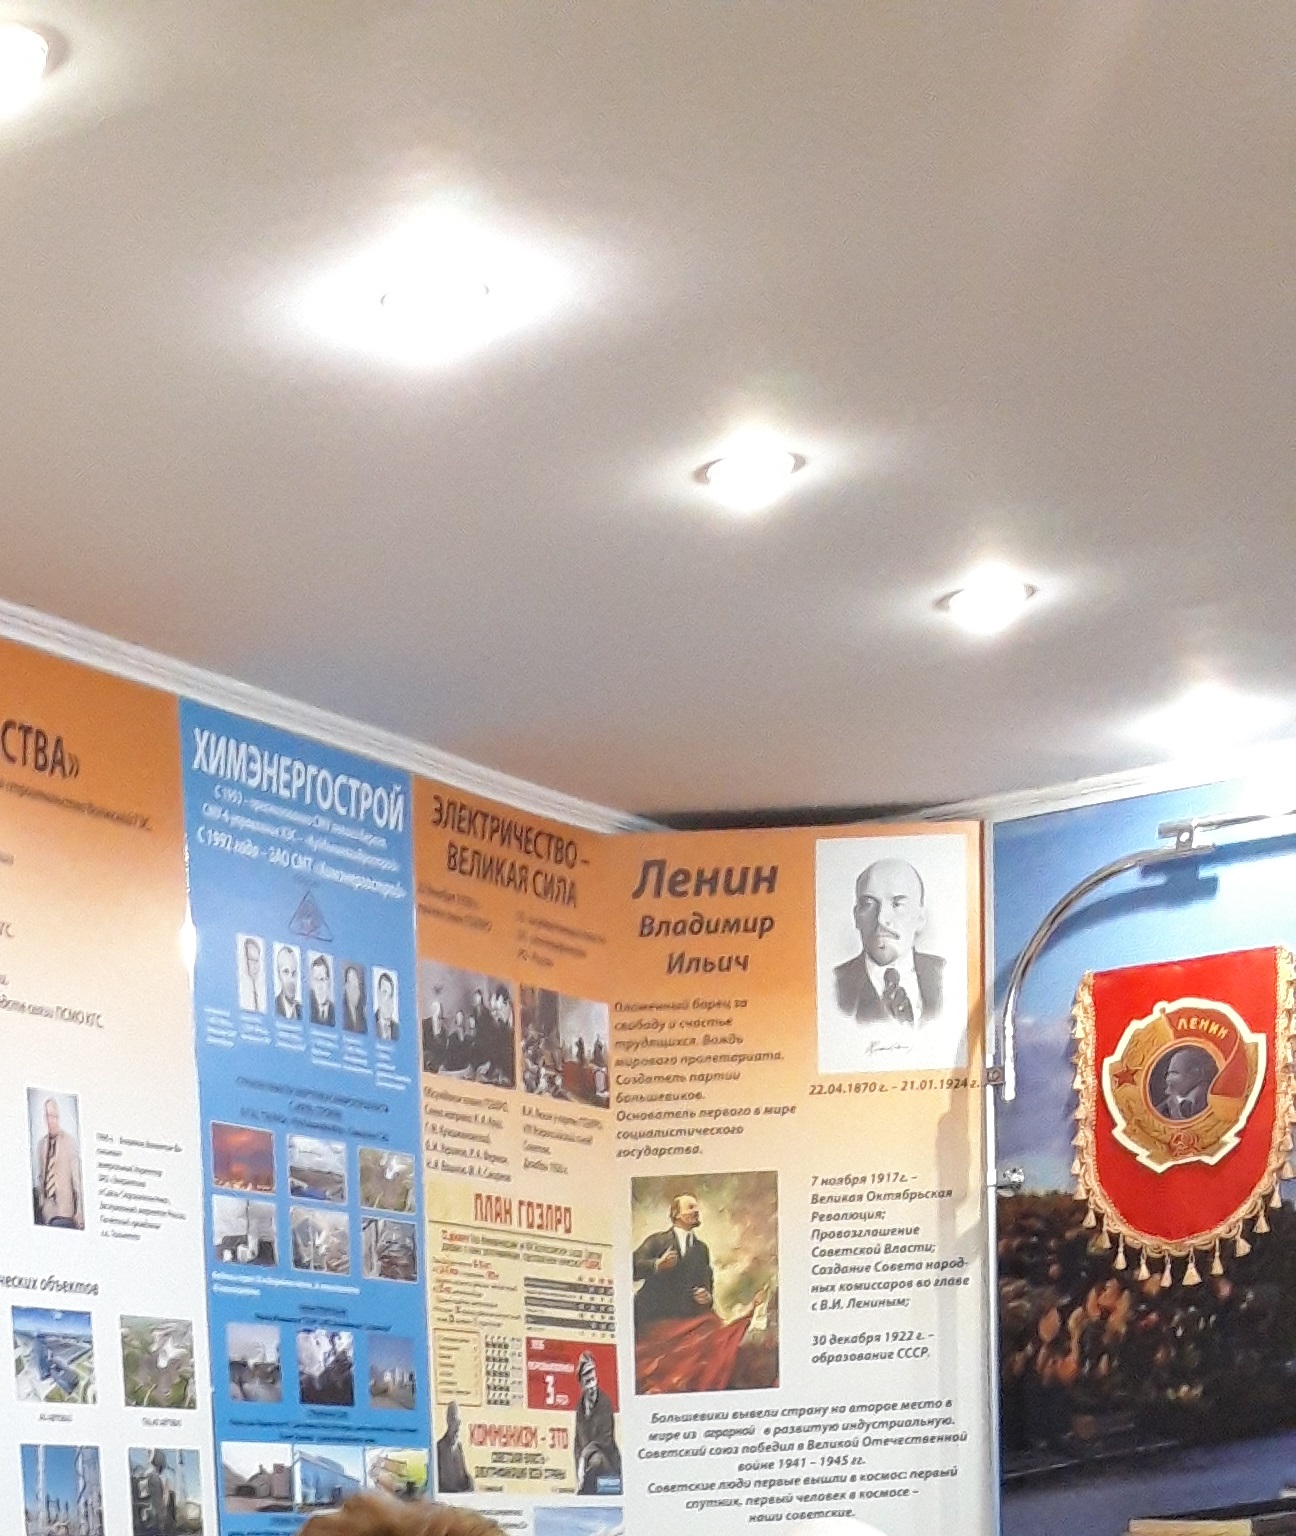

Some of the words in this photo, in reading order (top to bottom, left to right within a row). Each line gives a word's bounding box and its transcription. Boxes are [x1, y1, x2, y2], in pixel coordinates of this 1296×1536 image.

[192, 727, 404, 832] ХИМЭНЕРГОСТРОЙ
[432, 794, 578, 870] ЭЛЕКТРИЧЕСТВО
[447, 840, 528, 893] ВЕЛИКАЯ
[532, 869, 576, 908] СИЛА
[631, 858, 779, 900] Ленин
[639, 911, 775, 939] Владимир
[666, 951, 750, 975] Ильич
[668, 1020, 676, 1029] и
[1177, 1016, 1230, 1040] ЛЕНИН
[702, 1033, 744, 1046] Вождь
[615, 1055, 678, 1069] мирового
[616, 1073, 687, 1086] Создатель
[689, 1071, 741, 1084] партии
[809, 1081, 877, 1096] 22.04.1870
[900, 1078, 968, 1092] 21.01.1924
[616, 1110, 696, 1122] Основатель
[698, 1106, 752, 1120] первого
[754, 1105, 761, 1116] в
[762, 1105, 797, 1117] мире
[616, 1125, 744, 1140] социалистического
[616, 1144, 704, 1159] государства.
[812, 1176, 820, 1187] 7
[821, 1173, 867, 1188] ноября
[811, 1192, 864, 1205] Великая
[867, 1188, 953, 1203] Октябрьская
[474, 1192, 513, 1226] ПЛАН
[517, 1200, 572, 1235] ГОЭЛРО
[810, 1209, 886, 1223] Революция;
[811, 1225, 921, 1241] Провозглашение
[812, 1243, 881, 1258] Советской
[884, 1242, 936, 1255] Власти;
[811, 1263, 871, 1276] Создание
[874, 1260, 923, 1273] Совета
[925, 1256, 969, 1272] народ-
[40, 1275, 99, 1296] объектов
[811, 1283, 836, 1294] ных
[838, 1278, 913, 1293] комиссаров
[916, 1278, 931, 1288] во
[933, 1276, 970, 1288] главе
[820, 1298, 844, 1310] В.И.
[846, 1297, 911, 1310] Лениным;
[812, 1334, 826, 1346] 30
[829, 1332, 881, 1346] декабря
[885, 1330, 913, 1343] 1922
[811, 1351, 894, 1366] образование
[651, 1410, 729, 1425] Большевики
[731, 1408, 779, 1421] вывели
[780, 1405, 829, 1420] страну
[830, 1403, 847, 1415] на
[901, 1399, 942, 1412] место
[648, 1431, 682, 1445] мире
[683, 1430, 697, 1441] из
[772, 1421, 839, 1438] развитую
[841, 1416, 956, 1433] индустриальную.
[638, 1444, 706, 1460] Советский
[709, 1444, 738, 1457] союз
[741, 1440, 795, 1455] победил
[807, 1436, 860, 1451] Великой
[862, 1431, 968, 1448] Отечественной
[738, 1459, 775, 1473] войне
[778, 1457, 807, 1471] 1941
[819, 1455, 849, 1468] 1945
[647, 1479, 716, 1495] Советские
[717, 1477, 751, 1491] люди
[754, 1475, 801, 1490] первые
[804, 1474, 847, 1486] вышли
[909, 1466, 958, 1481] первый
[745, 1492, 793, 1507] первый
[795, 1489, 847, 1503] человек
[859, 1486, 910, 1500] космосе
[749, 1511, 783, 1523] наши
